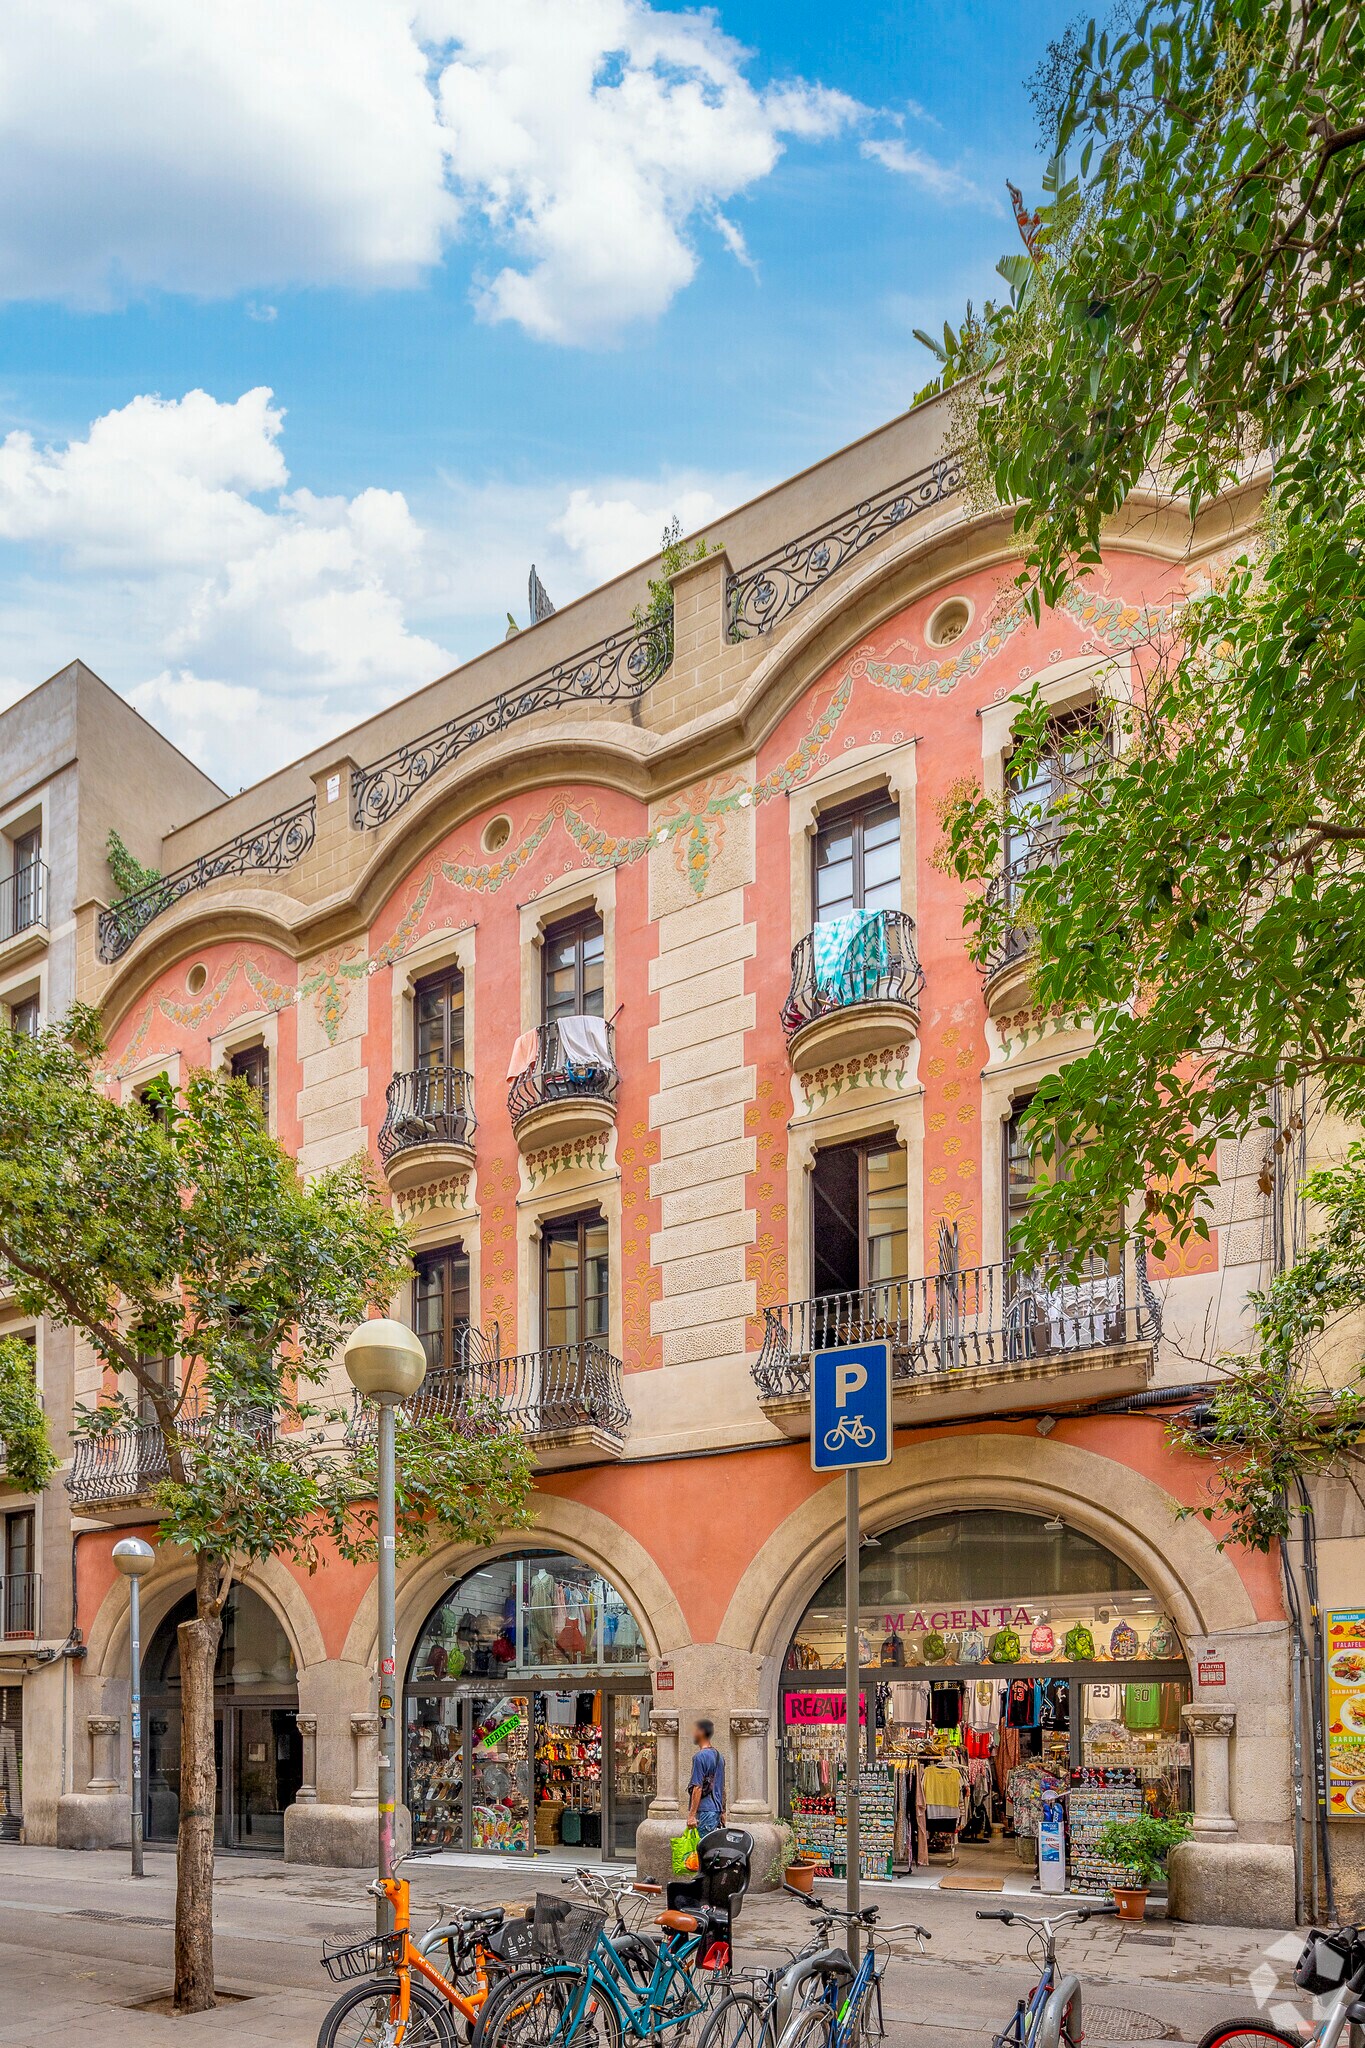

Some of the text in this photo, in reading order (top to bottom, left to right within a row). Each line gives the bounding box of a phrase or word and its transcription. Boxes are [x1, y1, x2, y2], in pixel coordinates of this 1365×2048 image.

[836, 1363, 868, 1408] P
[884, 1607, 1033, 1633] MAGENTA
[943, 1631, 984, 1644] PARIS
[1092, 1685, 1111, 1699] 23
[1134, 1689, 1150, 1703] 30
[484, 1716, 519, 1747] REBAIXES
[425, 1963, 443, 1982] DONKEY
